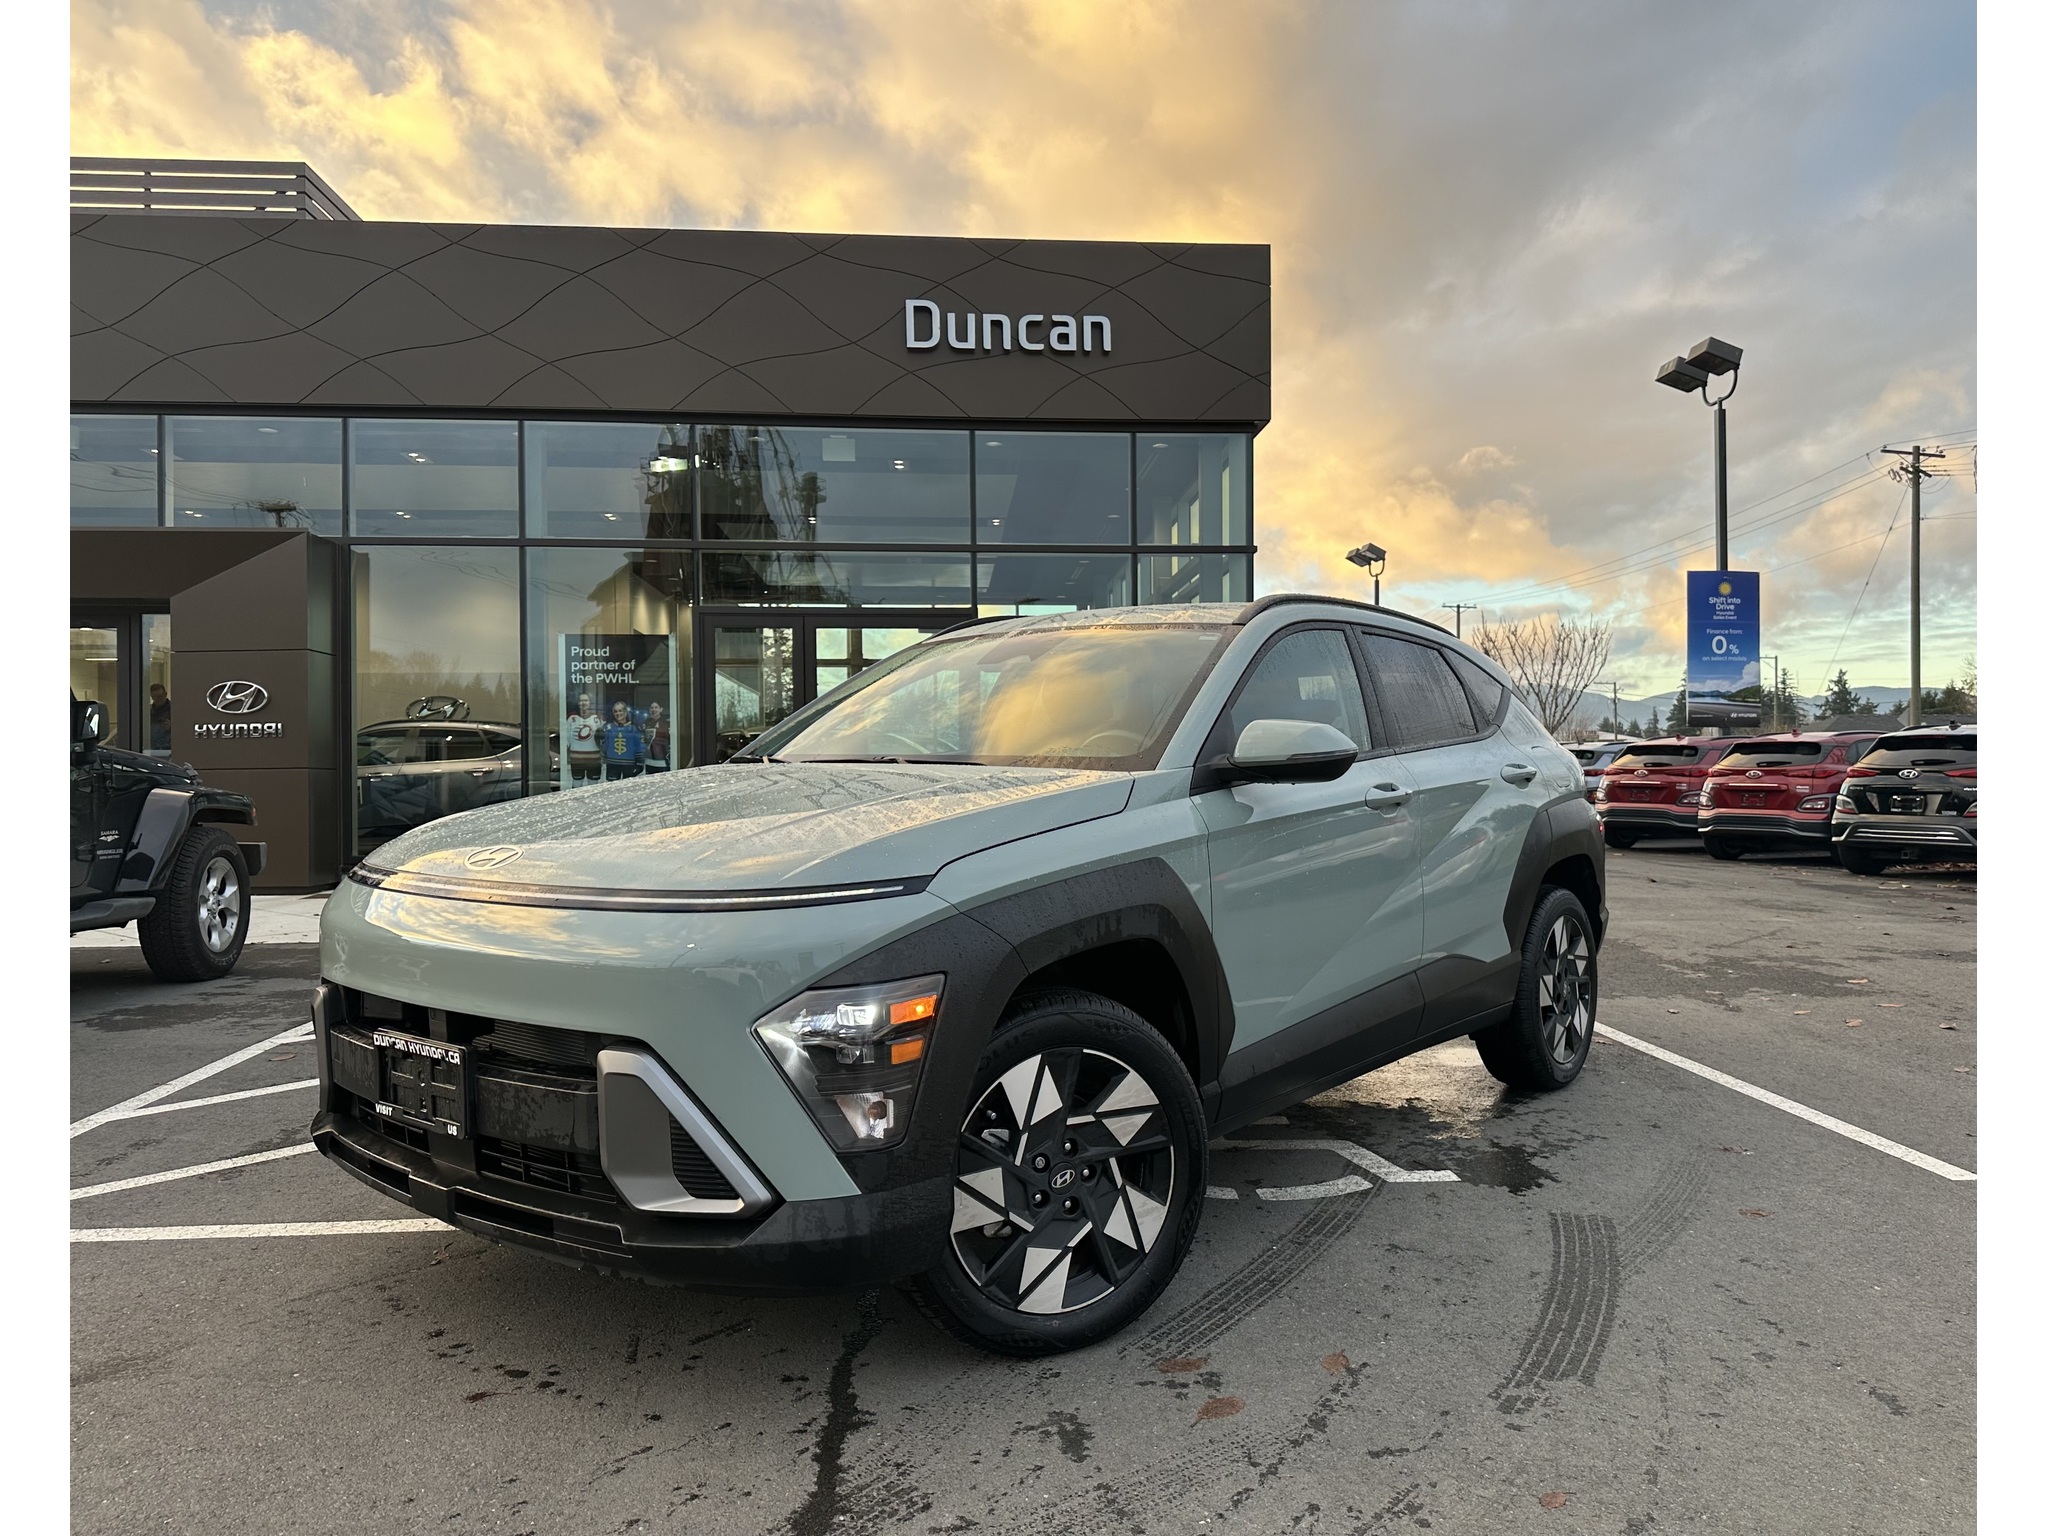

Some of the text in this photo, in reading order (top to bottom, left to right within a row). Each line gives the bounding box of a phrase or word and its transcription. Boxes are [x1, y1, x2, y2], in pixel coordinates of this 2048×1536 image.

[905, 299, 1112, 352] Duncan
[1708, 596, 1741, 604] Shift into
[1715, 603, 1735, 611] Drive
[571, 645, 610, 657] Proud
[571, 659, 636, 672] partner of
[571, 673, 640, 684] the PWHL.
[194, 722, 283, 739] HYUNDAI
[375, 1103, 393, 1117] VISIT
[447, 1124, 458, 1136] US
